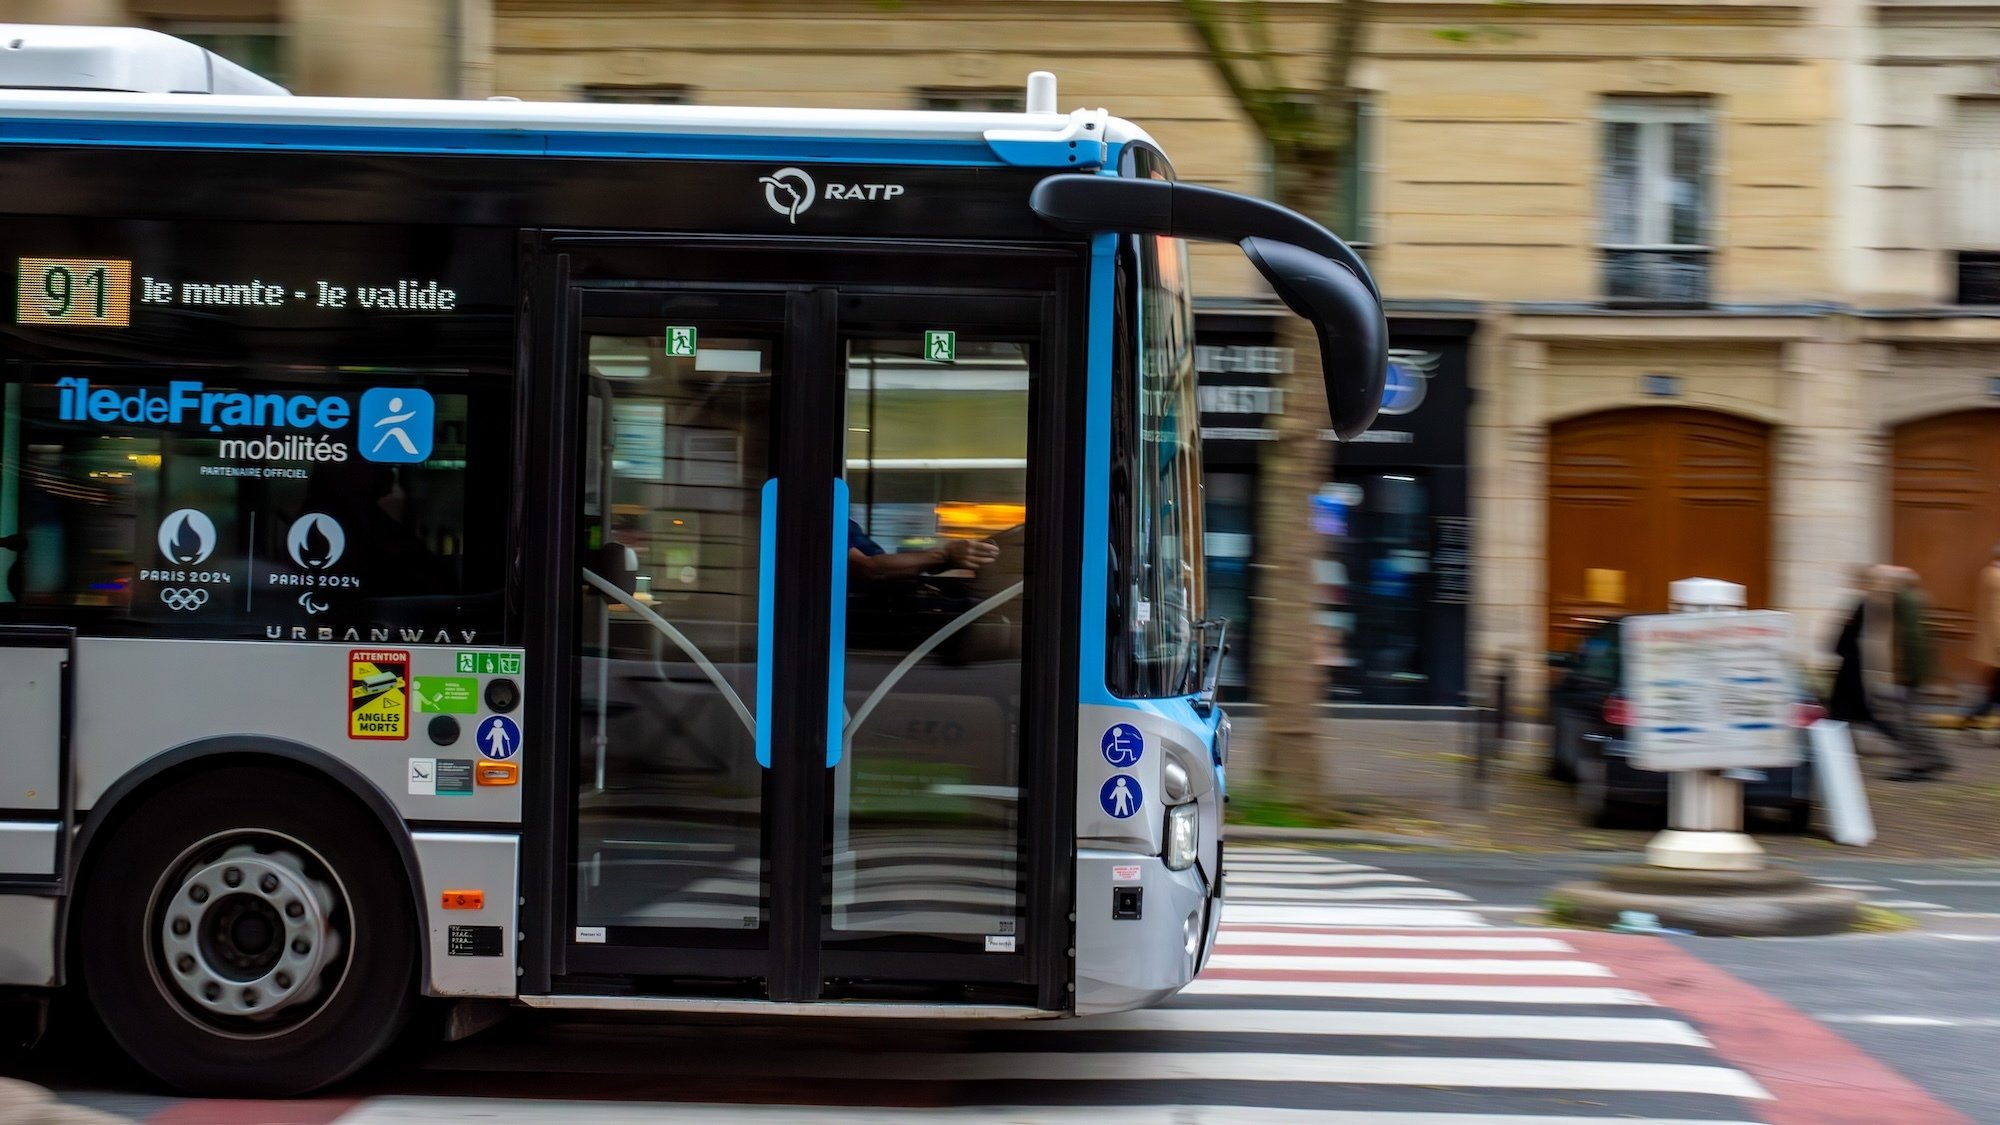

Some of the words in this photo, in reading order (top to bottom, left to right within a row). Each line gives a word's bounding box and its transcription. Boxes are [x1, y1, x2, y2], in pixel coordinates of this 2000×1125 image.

[824, 183, 905, 201] RATP
[45, 266, 109, 318] 91
[182, 279, 285, 306] monte
[357, 279, 456, 310] valide
[219, 434, 348, 462] mobilités
[199, 465, 262, 478] PARTENAIRE
[262, 468, 309, 479] OFFICIEL
[188, 571, 231, 584] 2024
[318, 575, 360, 588] 2024
[266, 625, 477, 644] URBANWAY
[352, 652, 407, 662] ATTENTION
[358, 712, 400, 723] ANGLES
[359, 723, 398, 732] MORTS
